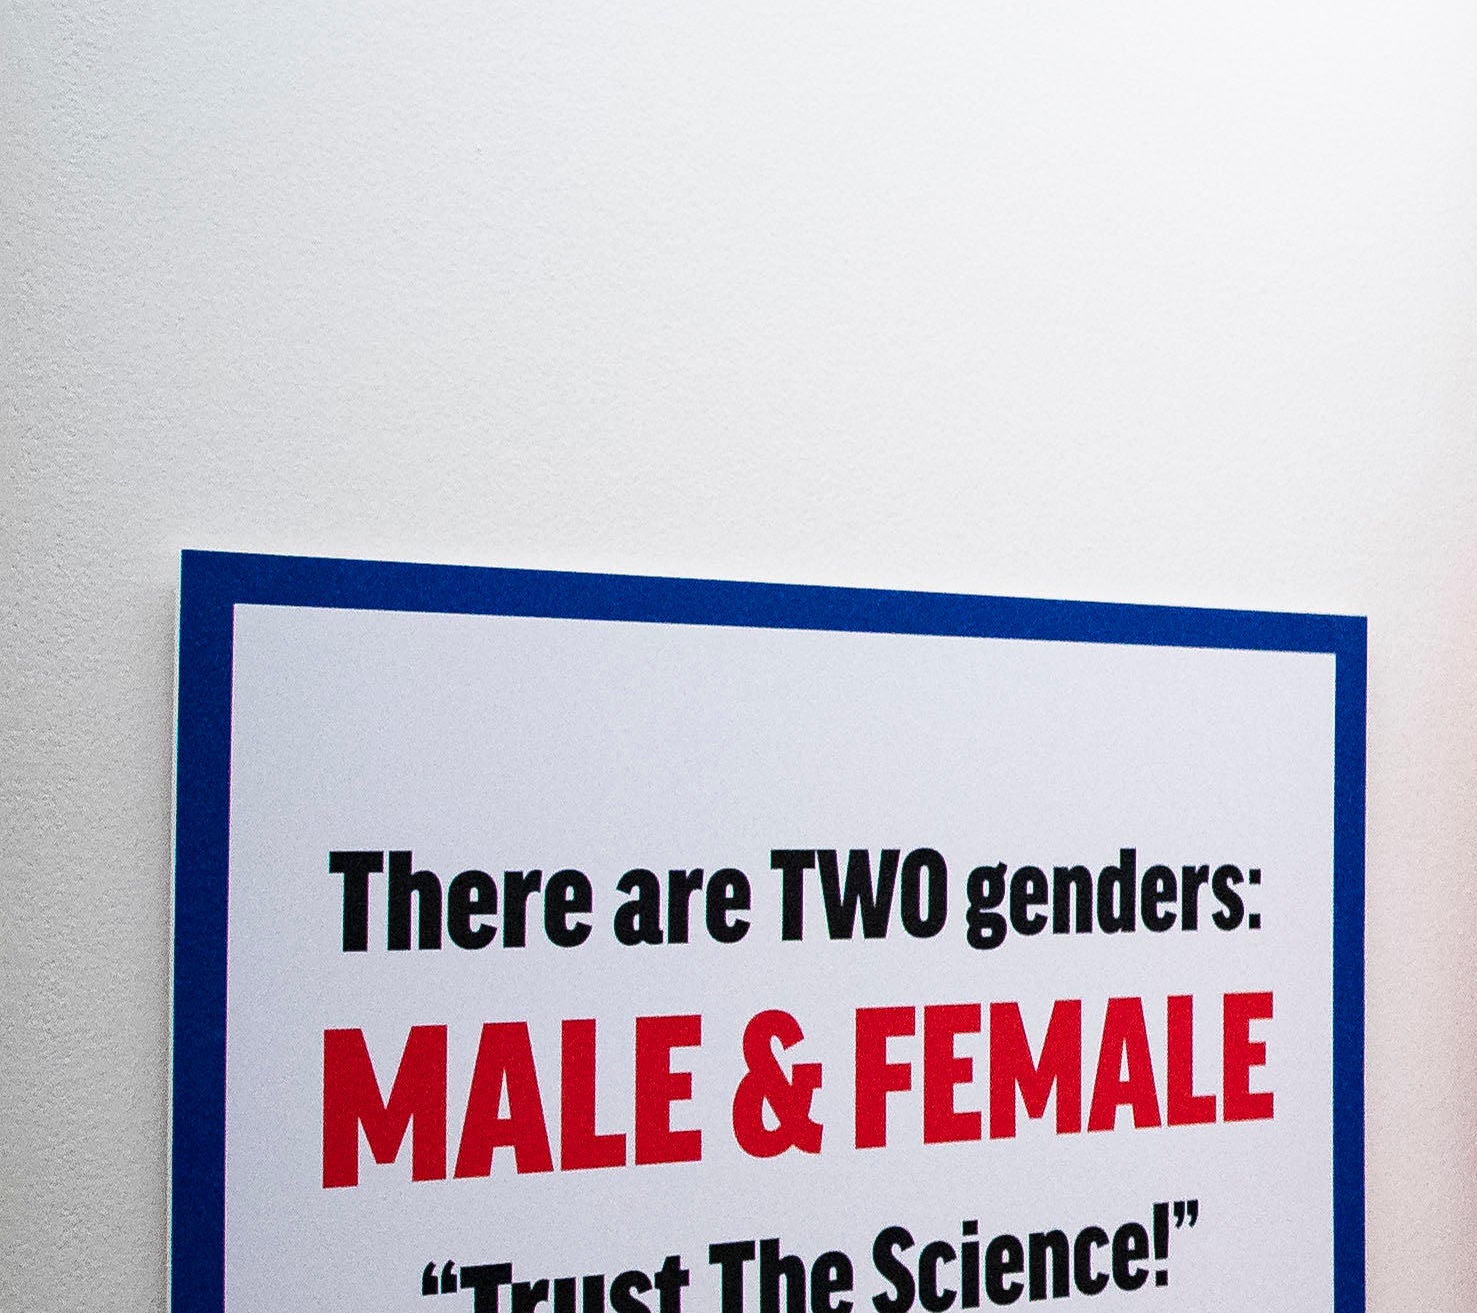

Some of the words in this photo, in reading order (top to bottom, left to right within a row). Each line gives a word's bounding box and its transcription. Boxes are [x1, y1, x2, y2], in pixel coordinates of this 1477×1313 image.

[328, 850, 592, 952] There
[613, 867, 751, 946] are
[769, 847, 948, 942] TWO
[965, 847, 1262, 951] genders:
[322, 1014, 703, 1189] MALE
[732, 1009, 824, 1159] &
[854, 990, 1275, 1150] FEMALE
